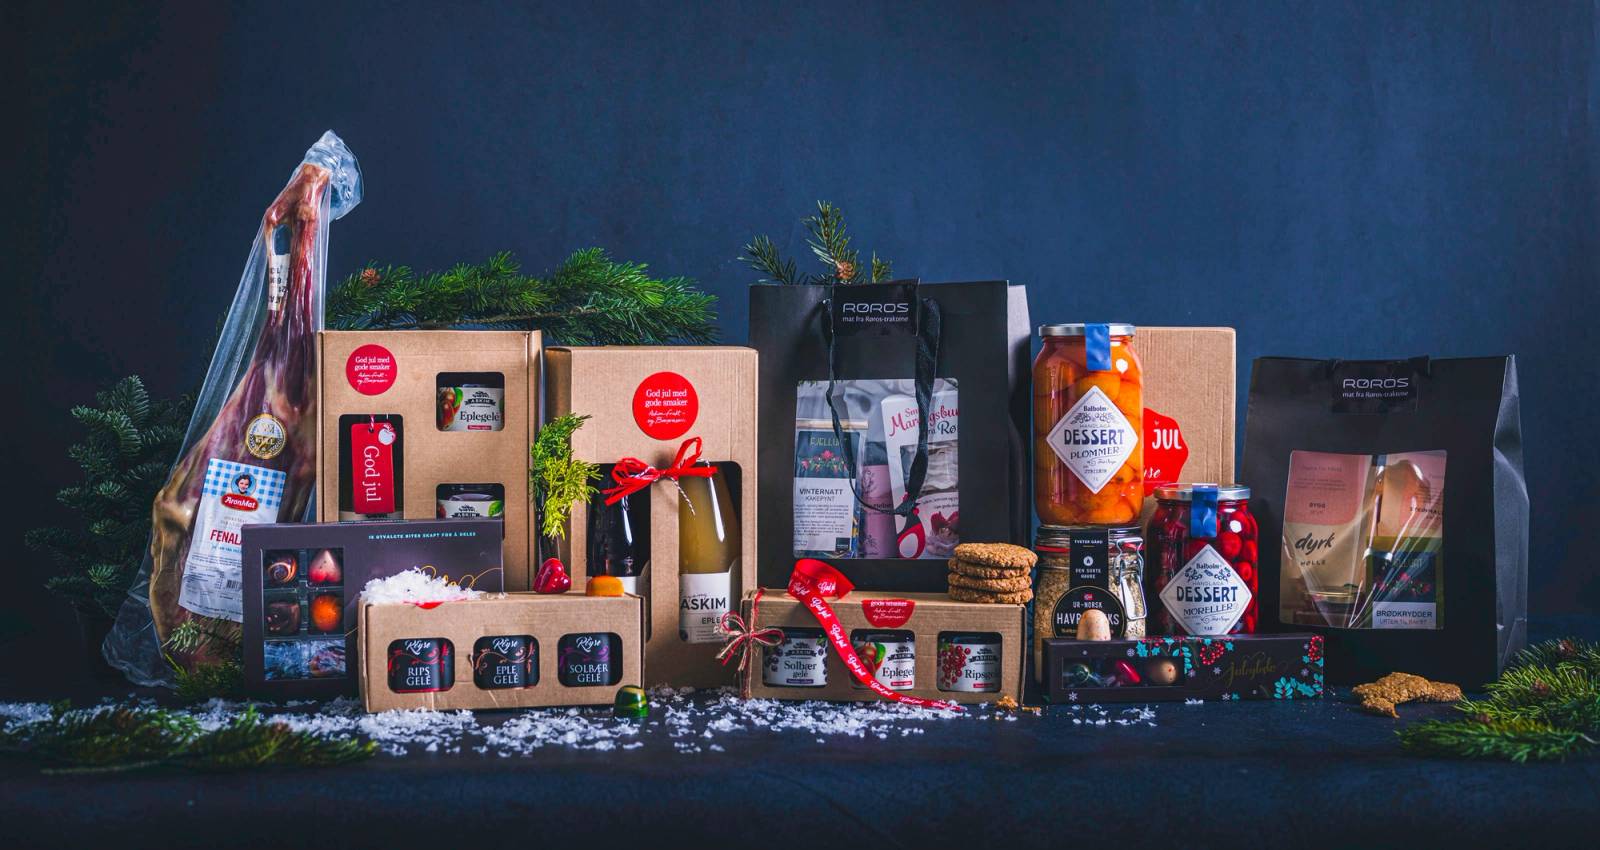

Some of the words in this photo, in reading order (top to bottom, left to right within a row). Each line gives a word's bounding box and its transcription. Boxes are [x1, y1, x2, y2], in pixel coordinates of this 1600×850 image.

[843, 303, 909, 313] RØROS
[368, 356, 376, 364] jul
[1343, 378, 1409, 388] RØROS
[646, 389, 660, 397] God
[662, 389, 671, 398] jul
[672, 388, 687, 397] med
[645, 398, 661, 408] gode
[662, 398, 687, 406] smaker
[460, 411, 500, 422] Eplegelé
[1064, 429, 1125, 445] DESSERT
[1152, 428, 1182, 450] JUL
[1070, 446, 1120, 460] PLOMMER
[363, 445, 380, 478] God
[362, 481, 382, 502] jul
[224, 496, 256, 509] AronMat
[210, 529, 242, 546] FENAL
[1295, 532, 1335, 555] dyrk
[1177, 586, 1238, 603] DESSERT
[681, 597, 726, 611] ASKIM
[1183, 603, 1233, 616] MORELLER
[1376, 610, 1433, 618] BRØDKRYDDER
[496, 665, 517, 675] EPLE
[569, 664, 609, 673] SOLBÆR
[784, 660, 817, 670] Solbær
[407, 667, 430, 676] RIPS
